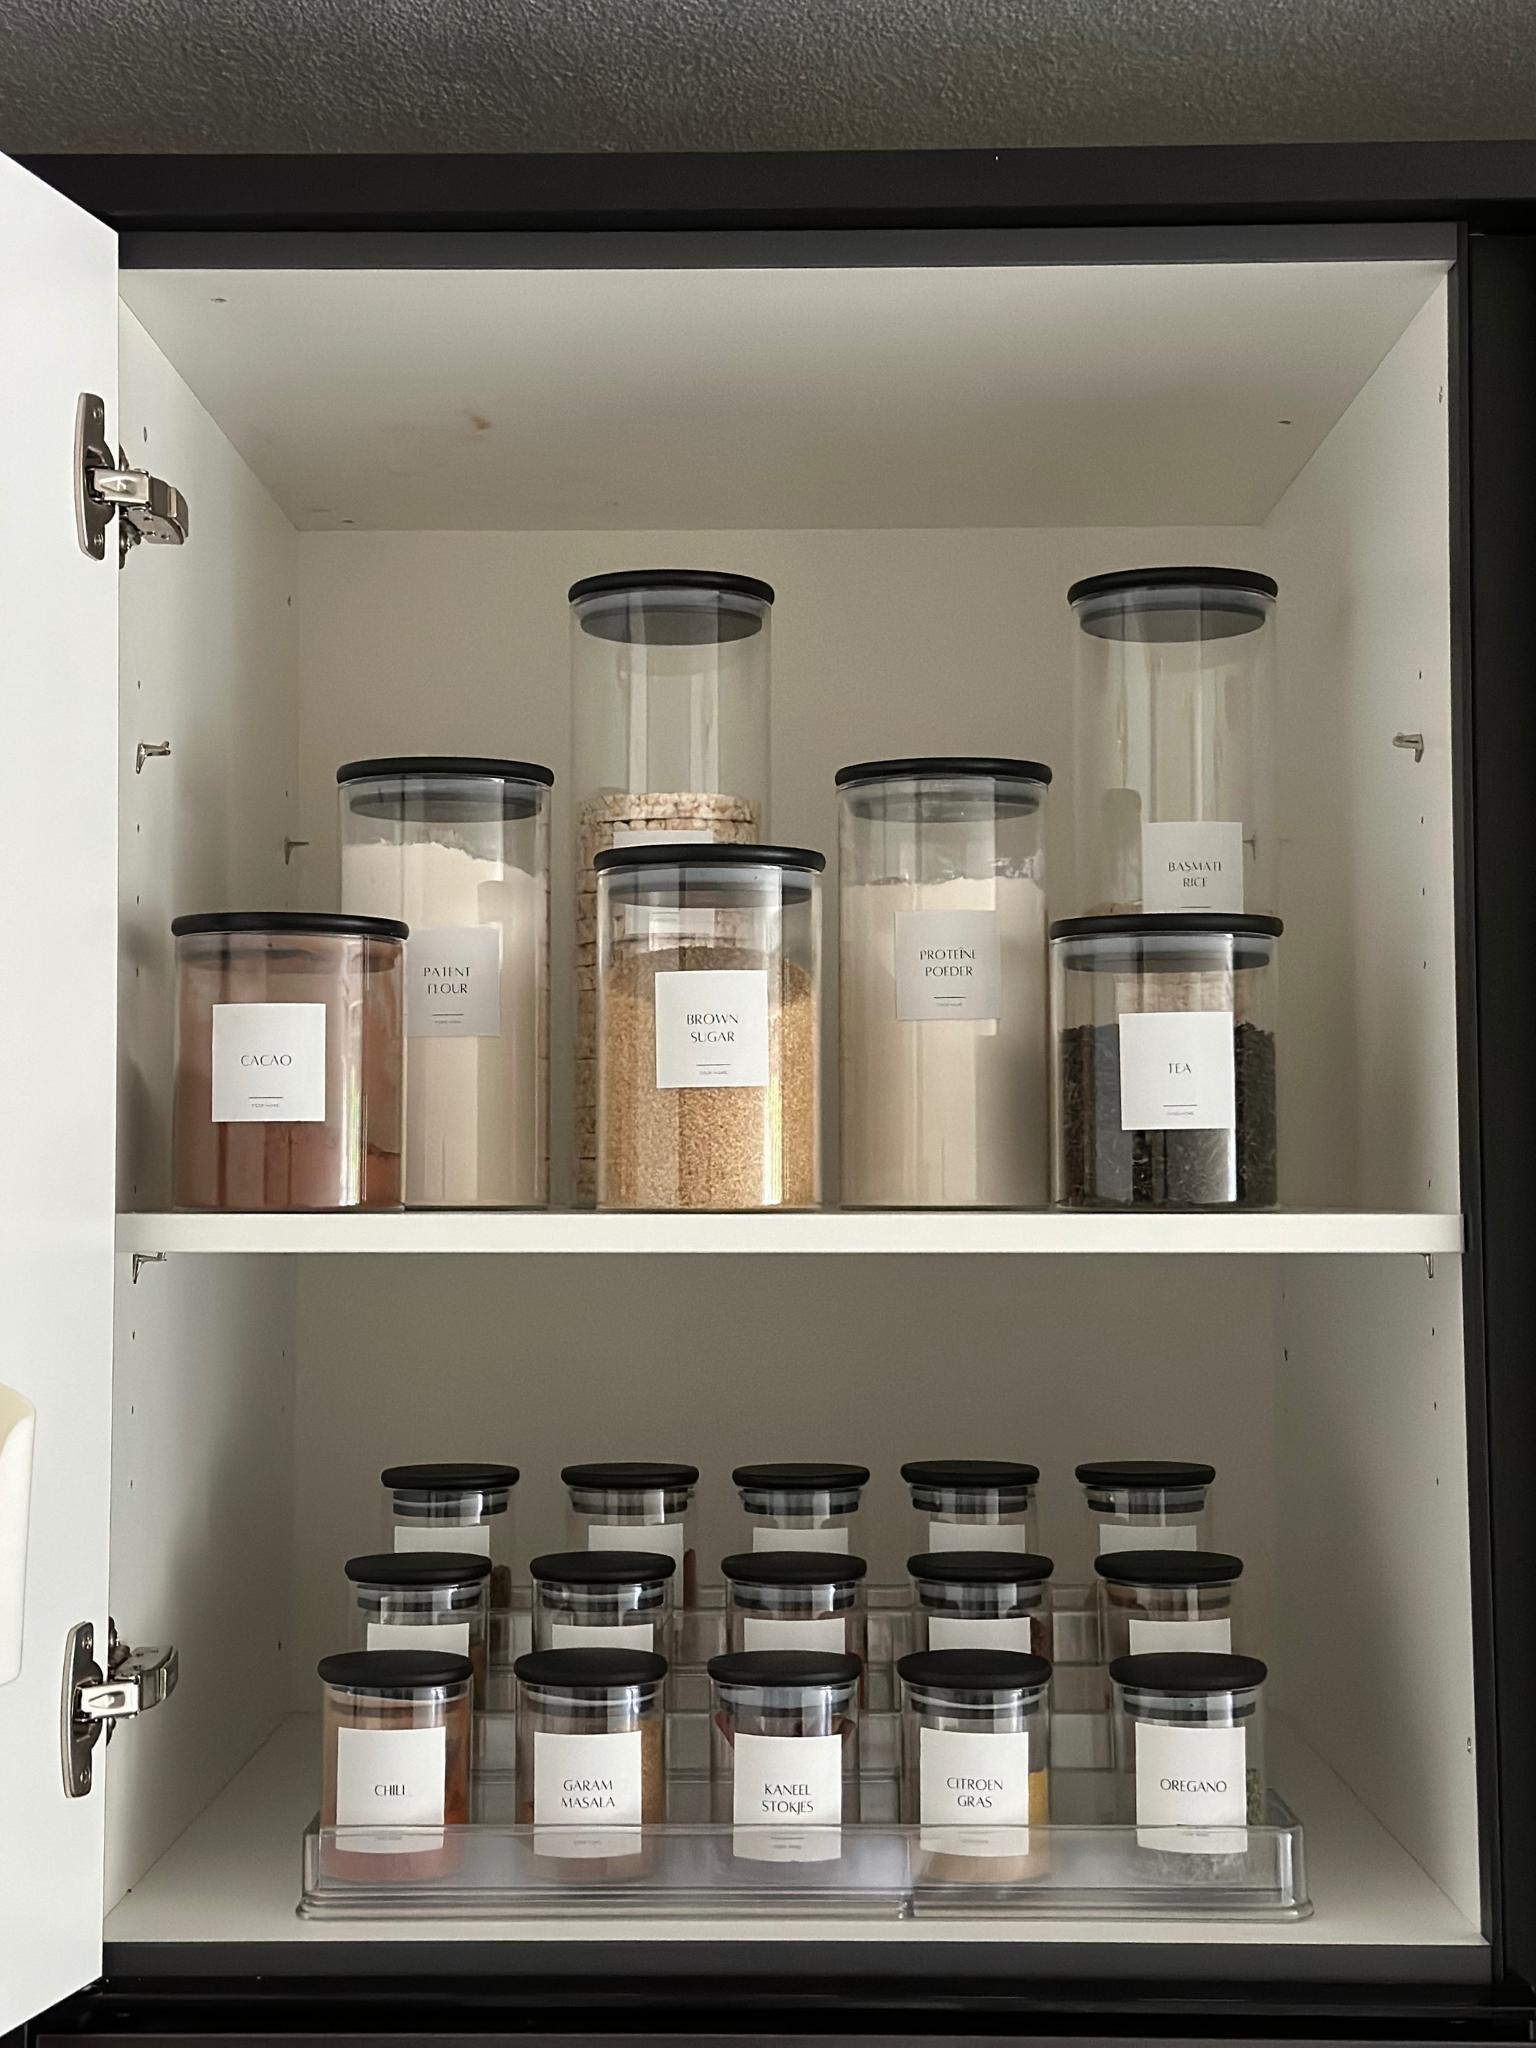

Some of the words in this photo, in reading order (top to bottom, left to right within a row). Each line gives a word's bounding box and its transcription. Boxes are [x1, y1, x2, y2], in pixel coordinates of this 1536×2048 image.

[1169, 862, 1222, 873] BASMATI
[1182, 877, 1208, 888] RICE
[423, 967, 471, 977] PATENT
[925, 965, 973, 977] POEDER
[428, 983, 468, 995] FLOUR
[687, 1013, 738, 1026] BROWN
[691, 1031, 735, 1044] SUGAR
[241, 1055, 292, 1067] CACAO
[1168, 1063, 1192, 1075] TEA
[375, 1784, 406, 1797] CHILI
[563, 1780, 613, 1793] GARAM
[765, 1783, 811, 1797] KANEEL
[946, 1777, 1004, 1792] CITROEN
[1160, 1779, 1228, 1793] OREGANO
[561, 1796, 616, 1810] MASALA
[762, 1799, 814, 1815] STOKJES
[957, 1795, 993, 1809] GRAS
